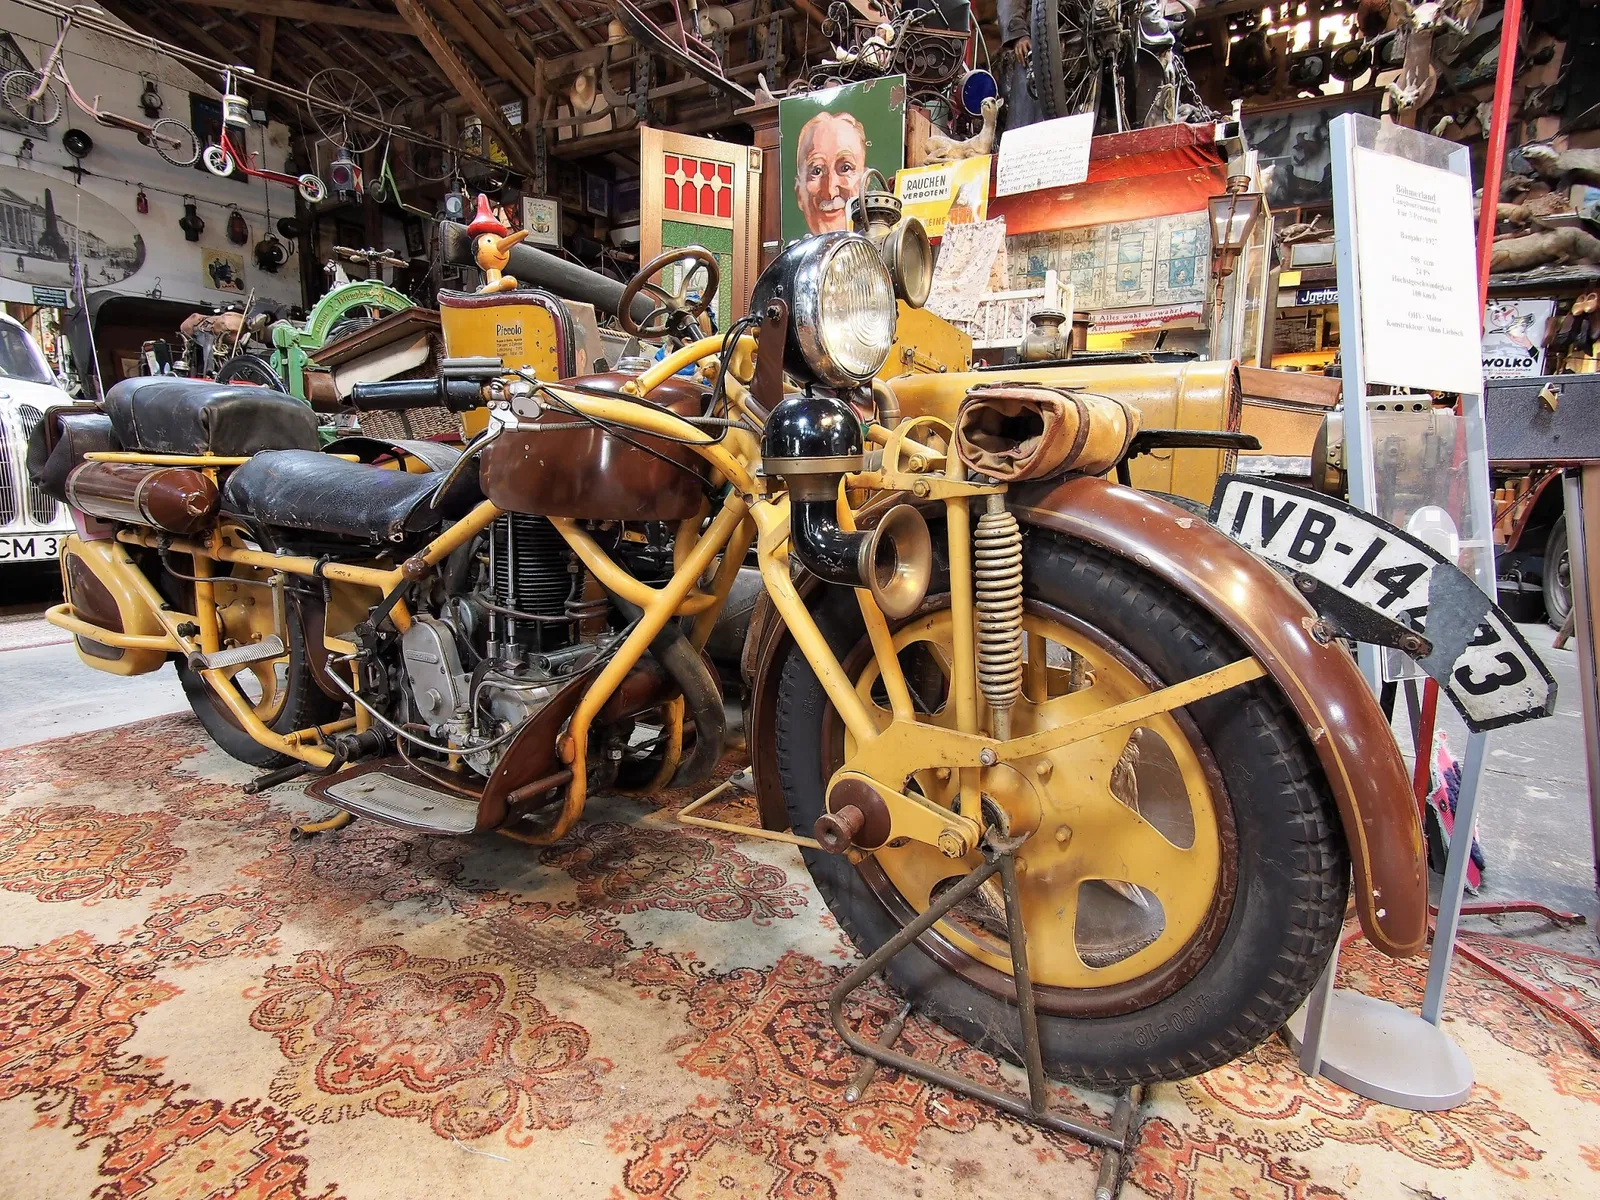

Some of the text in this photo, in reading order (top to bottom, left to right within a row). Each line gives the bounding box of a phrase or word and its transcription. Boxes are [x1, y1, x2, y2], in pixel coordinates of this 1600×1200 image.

[906, 175, 946, 191] RAUCHEN
[902, 188, 948, 200] VERBOTEN!
[1396, 184, 1436, 202] Böhmerland
[496, 324, 522, 336] Piccolo
[1482, 358, 1533, 367] WOLKO
[43, 537, 60, 556] 3
